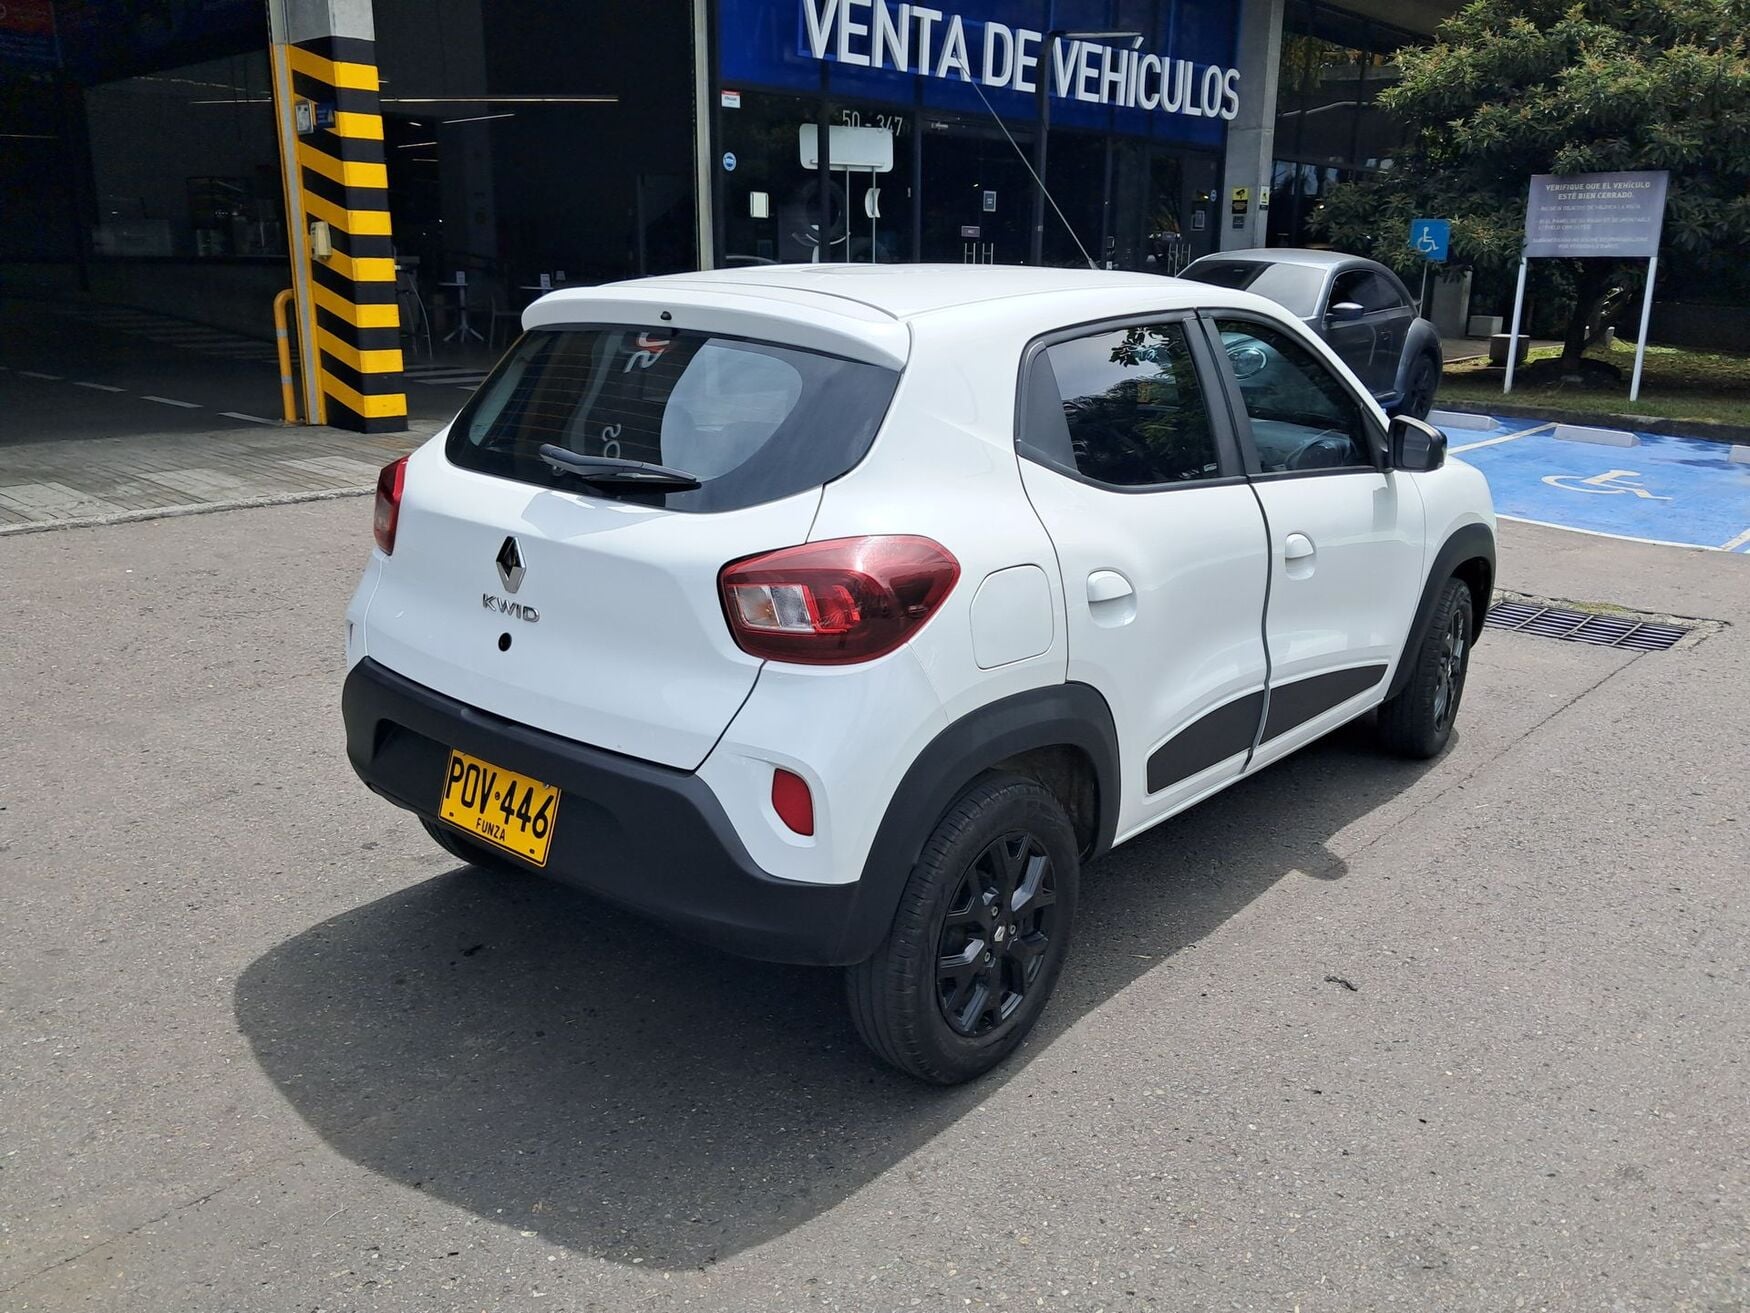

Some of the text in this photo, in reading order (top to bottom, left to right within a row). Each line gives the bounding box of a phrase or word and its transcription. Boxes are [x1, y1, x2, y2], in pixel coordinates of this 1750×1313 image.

[803, 0, 1240, 120] VENTA DE VEHÍCULOS
[1545, 183, 1584, 191] VERIFIQUE
[1585, 182, 1600, 190] QUE
[1613, 181, 1651, 189] VEHÍCULO
[1558, 192, 1576, 200] ESTÉ
[482, 594, 540, 623] KWID
[476, 818, 506, 842] FUNZA
